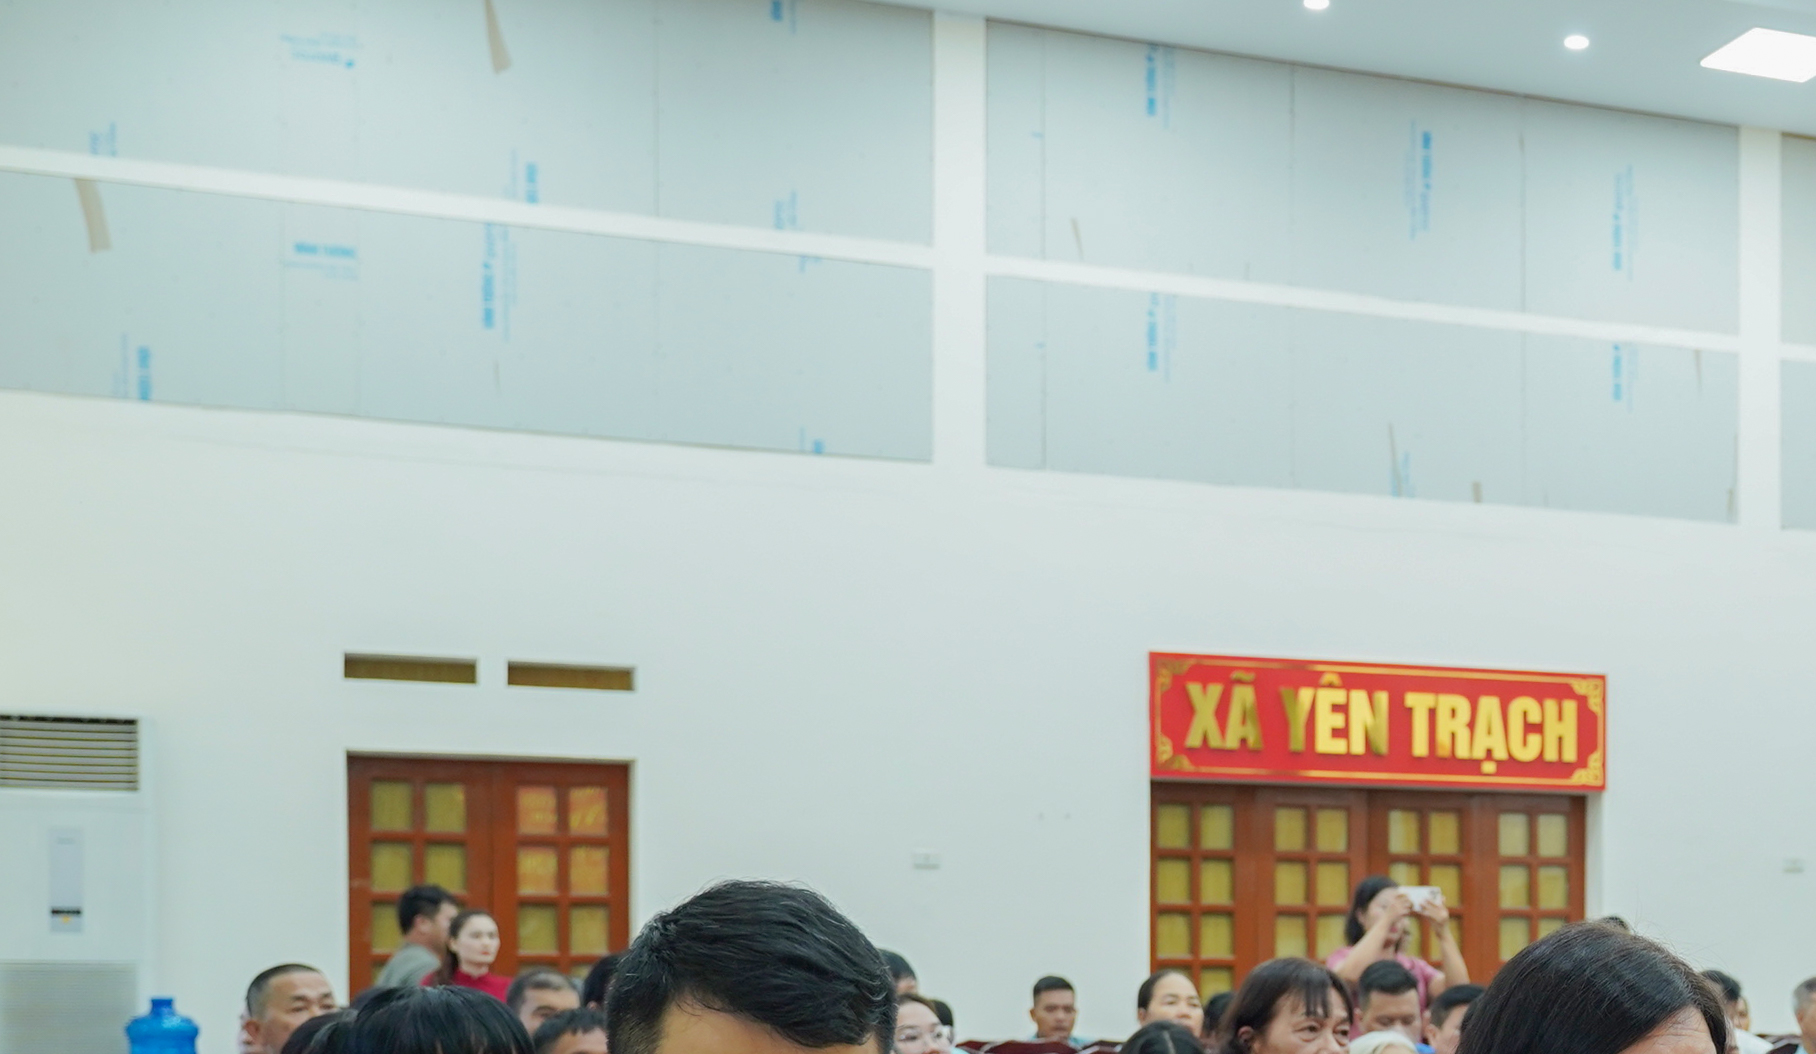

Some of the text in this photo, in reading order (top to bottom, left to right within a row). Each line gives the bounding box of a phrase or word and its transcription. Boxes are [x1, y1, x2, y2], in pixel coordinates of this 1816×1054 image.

[1185, 670, 1578, 775] XÃ YÊN TRẠCH
